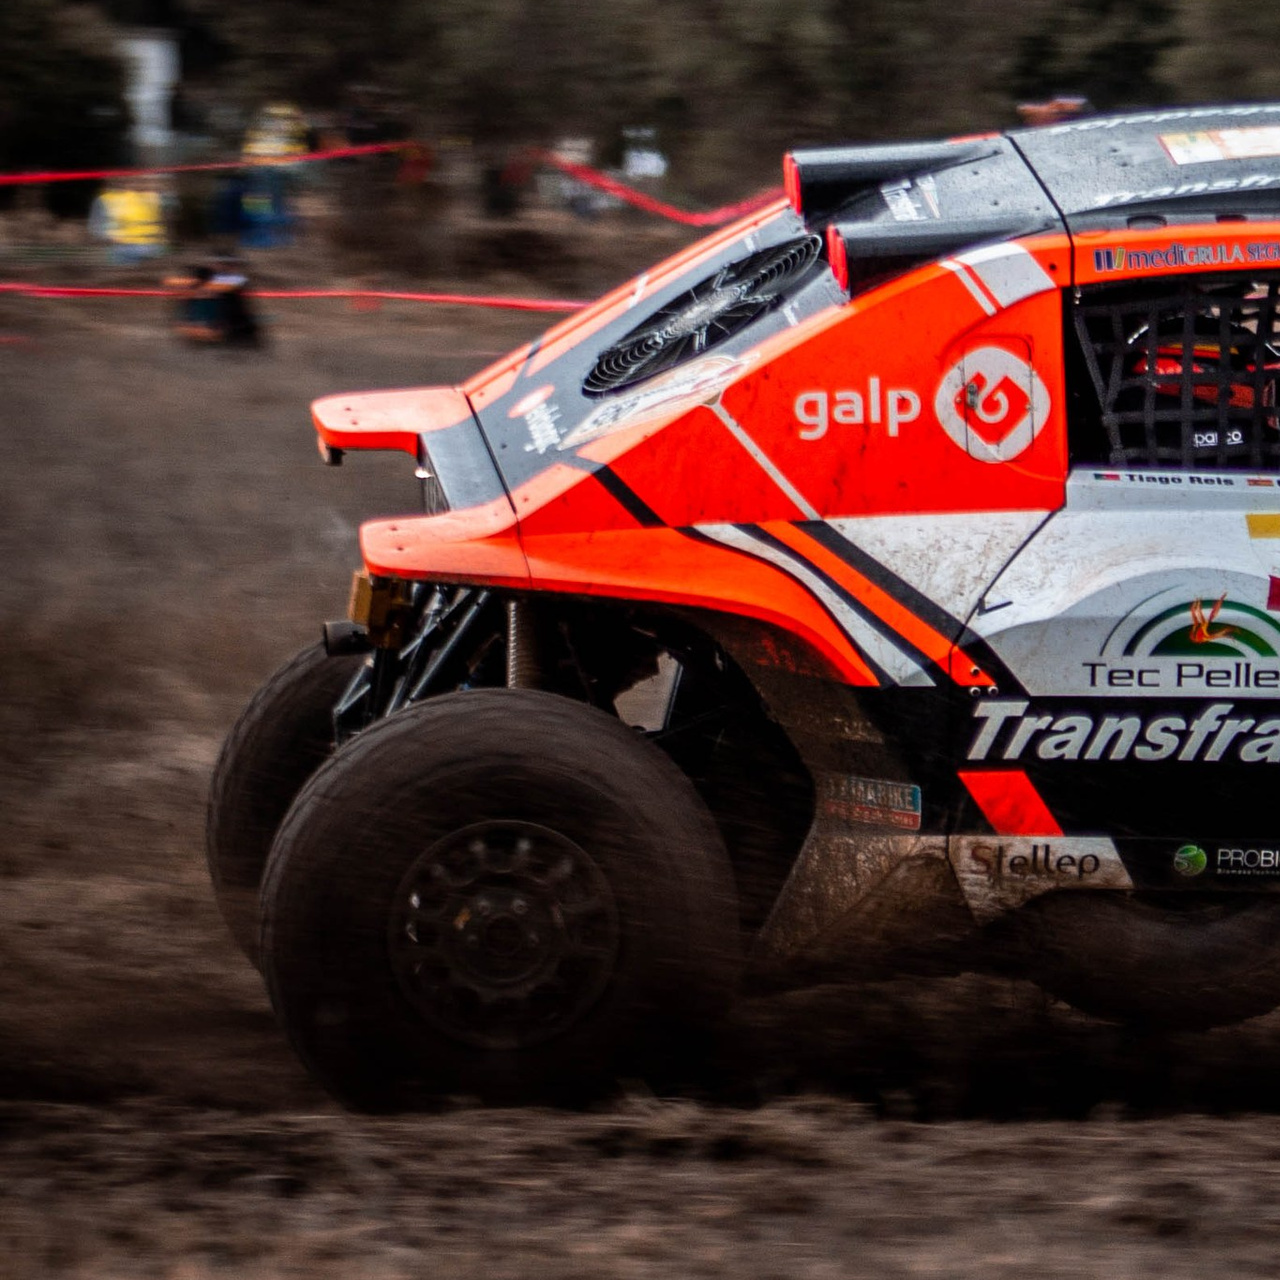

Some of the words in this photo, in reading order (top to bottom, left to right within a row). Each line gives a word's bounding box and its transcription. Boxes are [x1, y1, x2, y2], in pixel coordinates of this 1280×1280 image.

[794, 376, 921, 440] galp
[1125, 473, 1183, 485] Tiago
[1188, 475, 1234, 486] Reis
[1082, 662, 1160, 688] Tec
